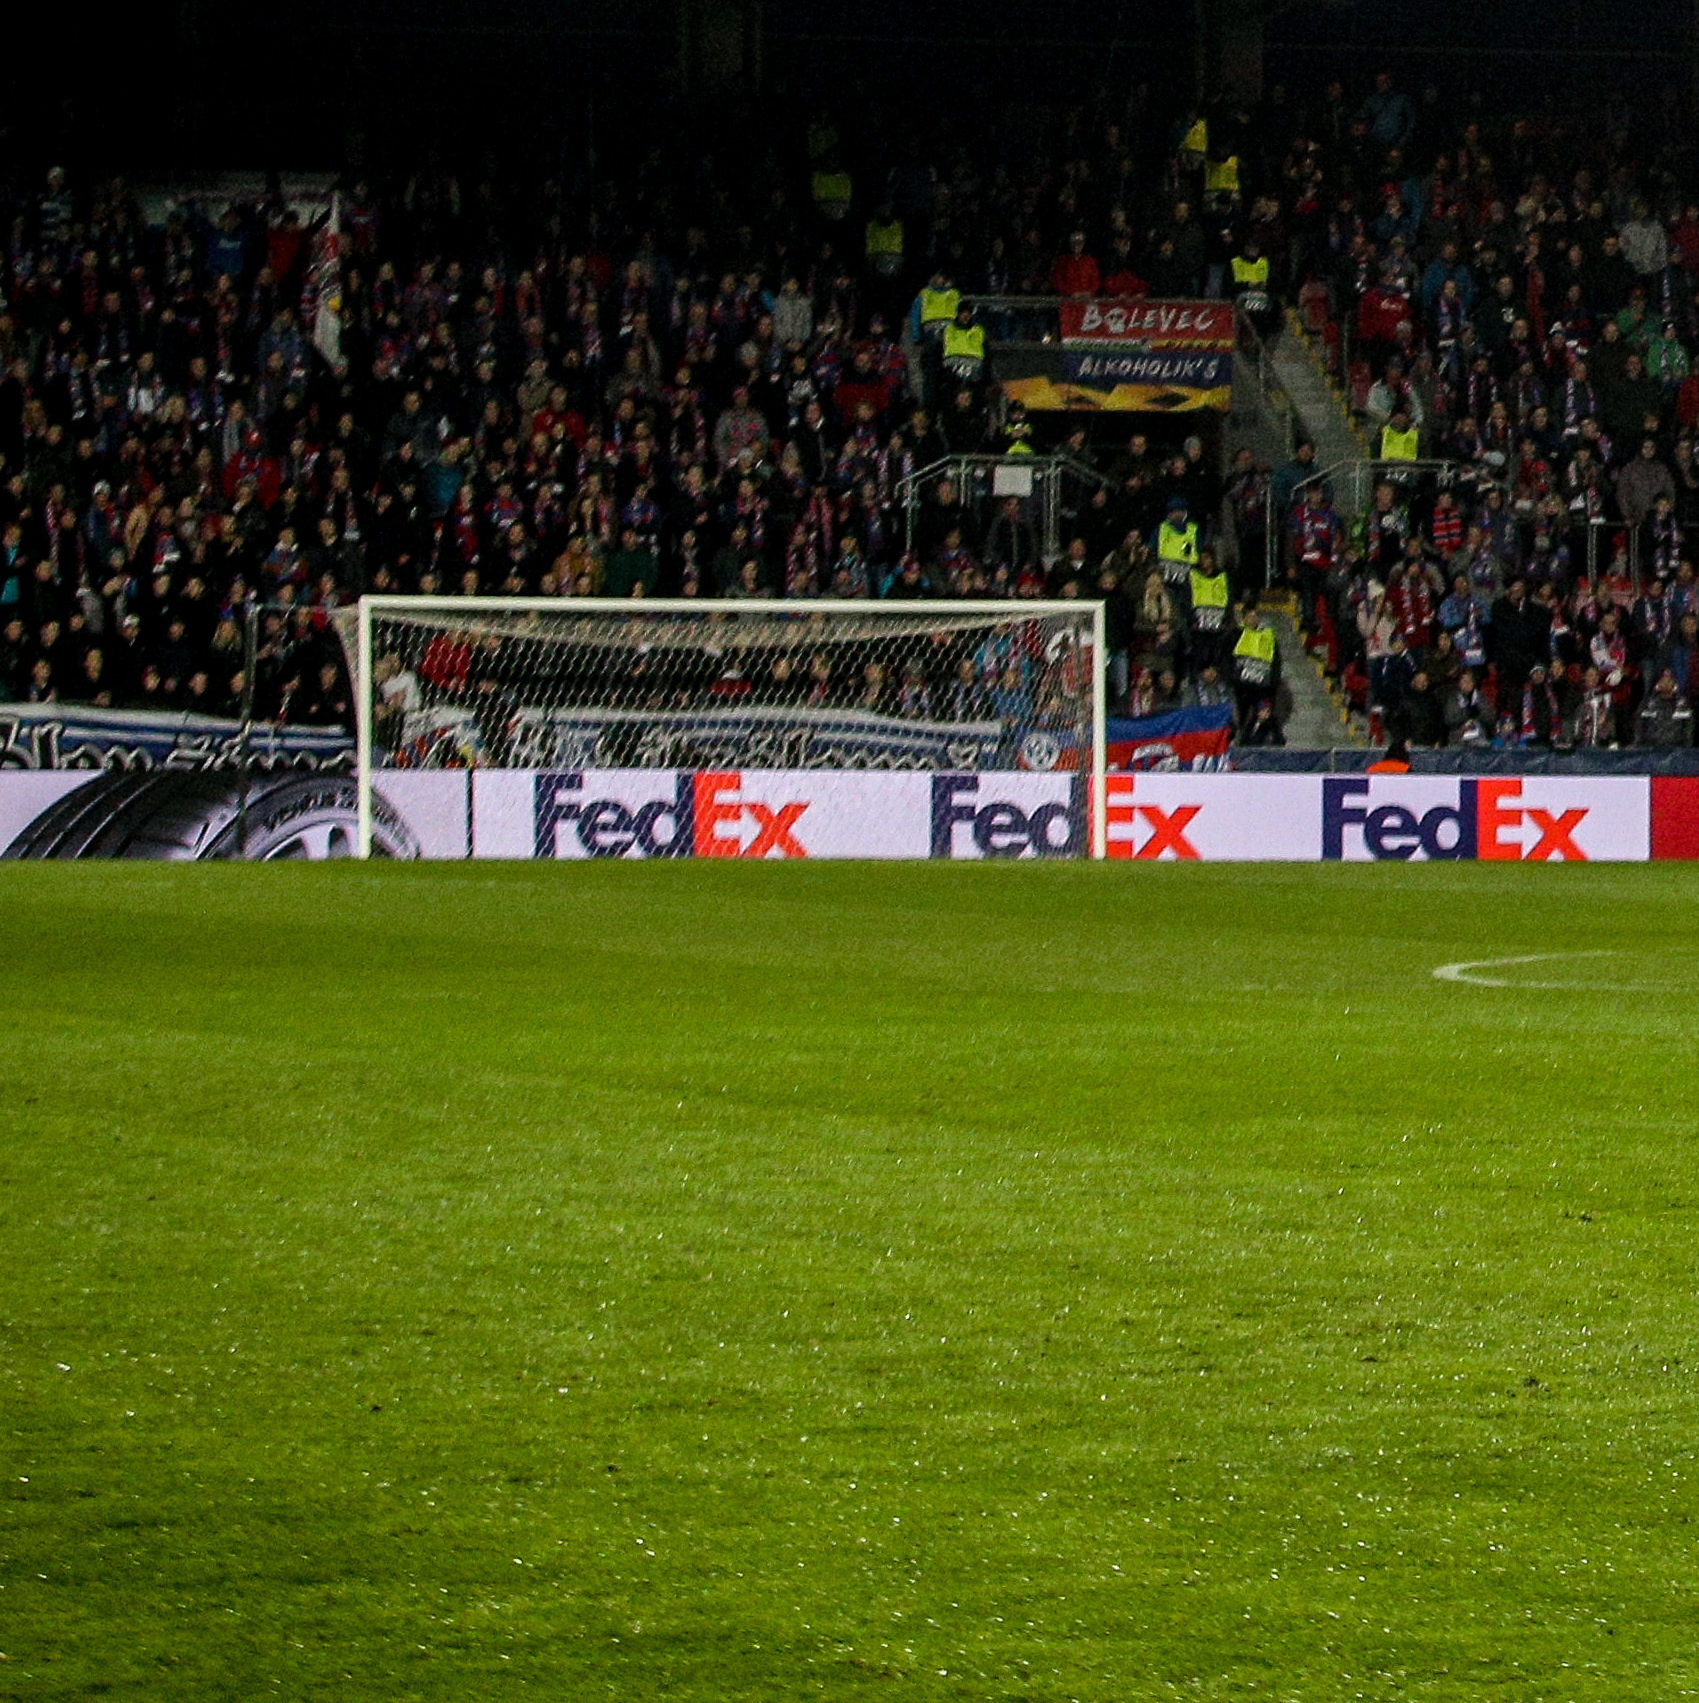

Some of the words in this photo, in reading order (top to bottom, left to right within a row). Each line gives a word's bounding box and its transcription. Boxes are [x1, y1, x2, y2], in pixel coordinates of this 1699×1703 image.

[534, 771, 812, 859] FedEx
[931, 775, 1203, 859] FedEx
[1322, 778, 1591, 861] FedEx
